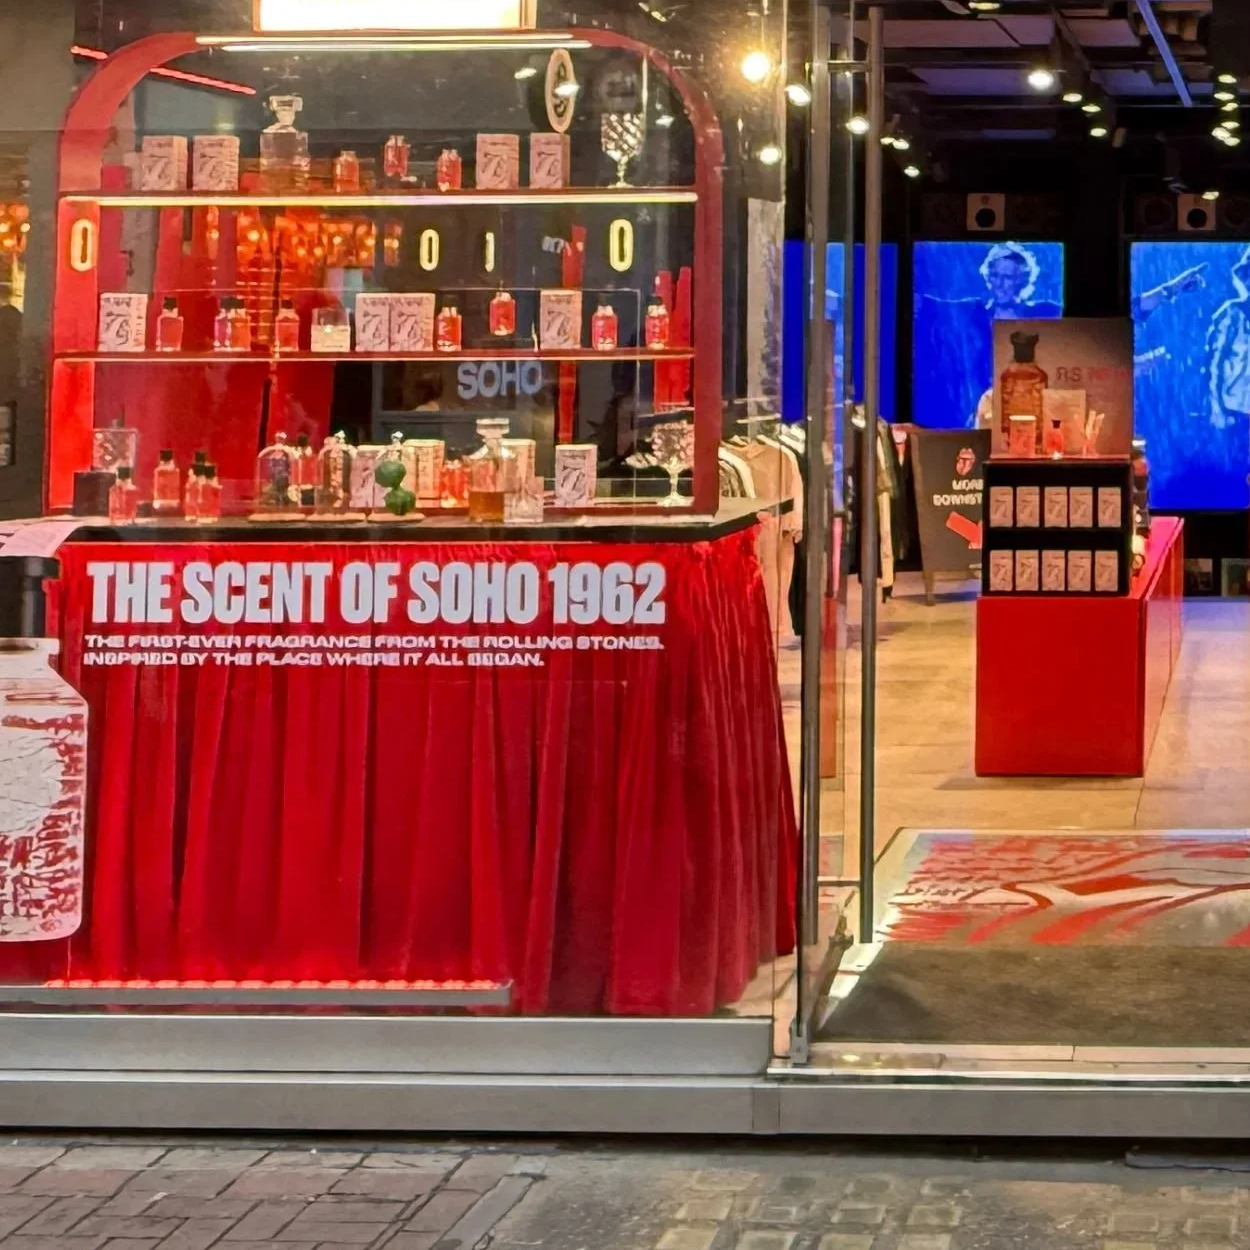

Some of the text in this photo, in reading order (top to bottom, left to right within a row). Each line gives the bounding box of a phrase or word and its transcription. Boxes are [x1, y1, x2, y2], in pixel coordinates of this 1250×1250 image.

[456, 360, 543, 400] SOHO
[86, 561, 667, 625] THE SCENT OF SOHO 1962
[84, 634, 665, 650] THE FIRST-EVER FRAGRANCE FROM THE ROLLING STONES.
[83, 651, 545, 667] INSPIRED BY THE PLACE WHERE IT ALL BEGAN.
